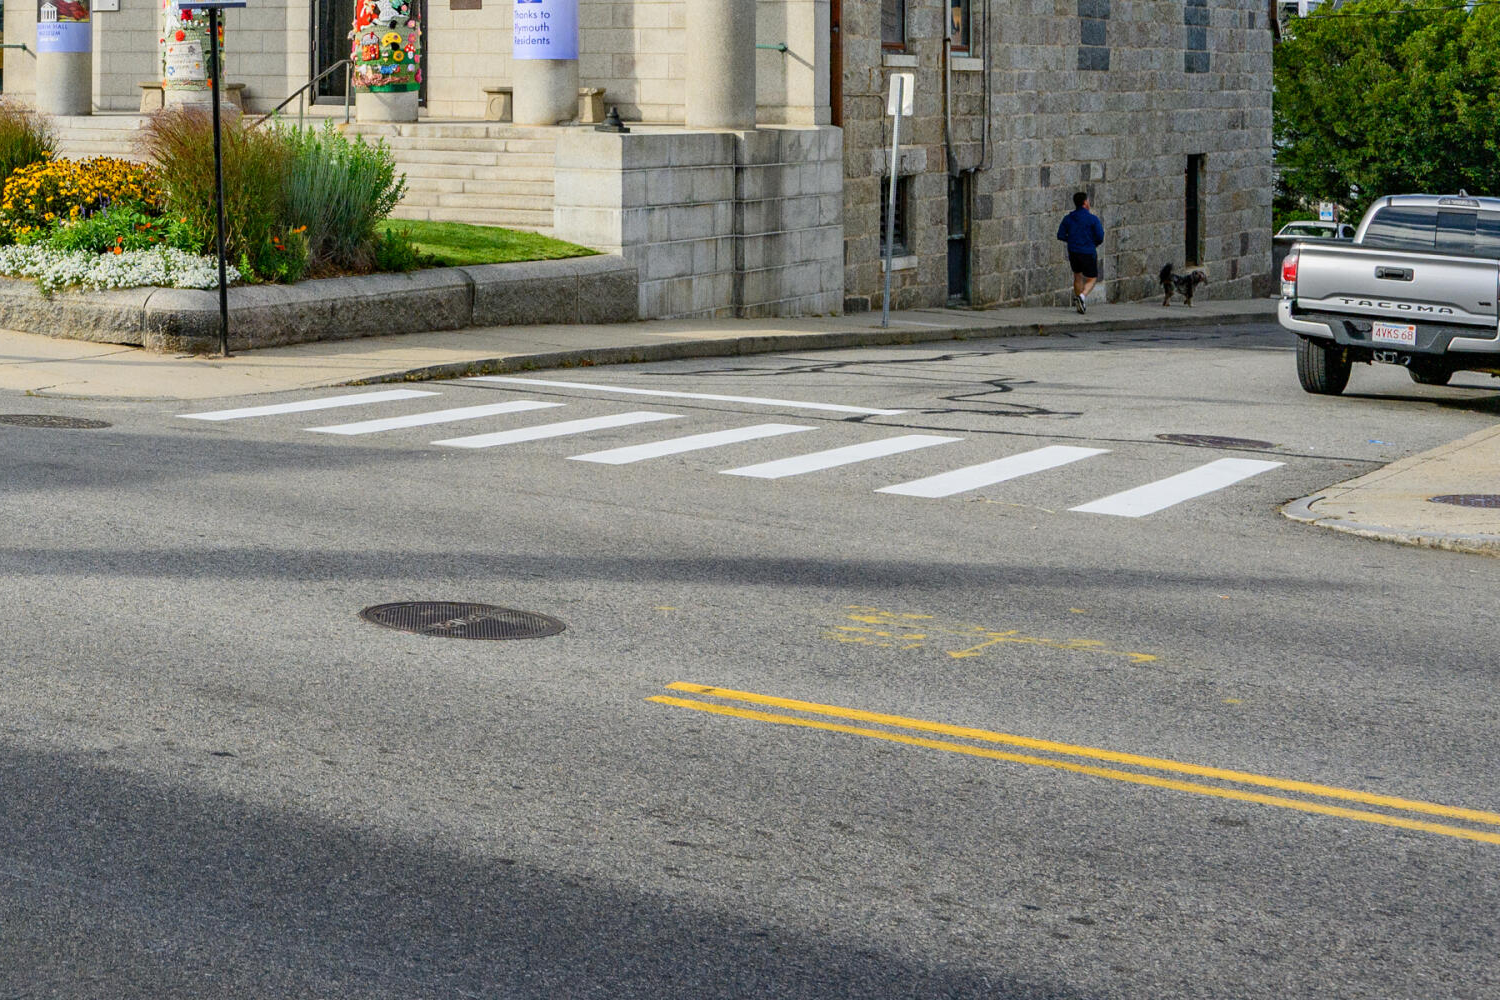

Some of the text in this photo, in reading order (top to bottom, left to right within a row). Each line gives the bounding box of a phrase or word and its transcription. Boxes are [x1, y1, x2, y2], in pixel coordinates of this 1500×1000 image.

[540, 10, 551, 19] to
[1339, 298, 1454, 314] TACOMA
[1375, 326, 1413, 340] 4VKS 68
